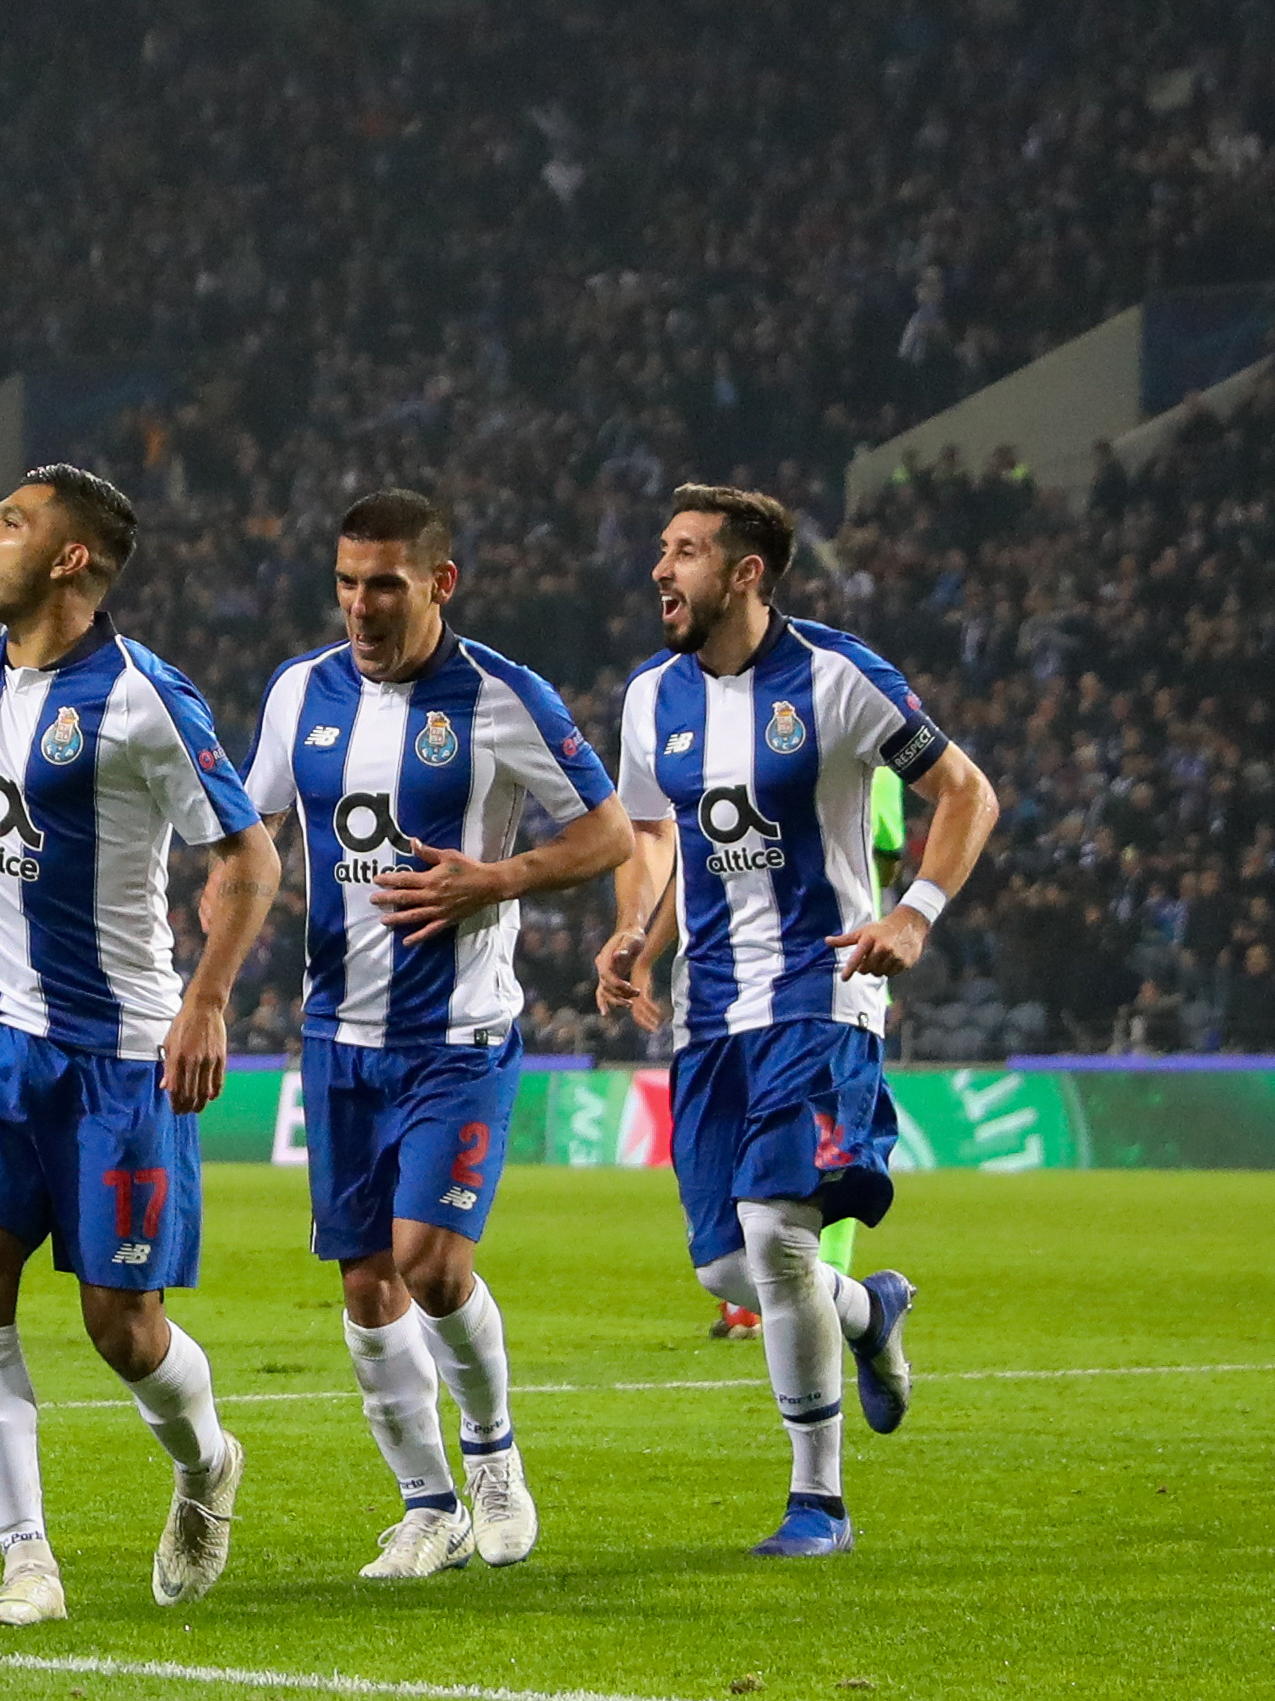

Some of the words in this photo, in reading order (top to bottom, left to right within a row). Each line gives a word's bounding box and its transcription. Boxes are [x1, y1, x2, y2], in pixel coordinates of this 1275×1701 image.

[894, 727, 931, 768] RESPECT
[707, 846, 785, 874] altice
[451, 1121, 490, 1188] 2
[103, 1167, 168, 1239] 17
